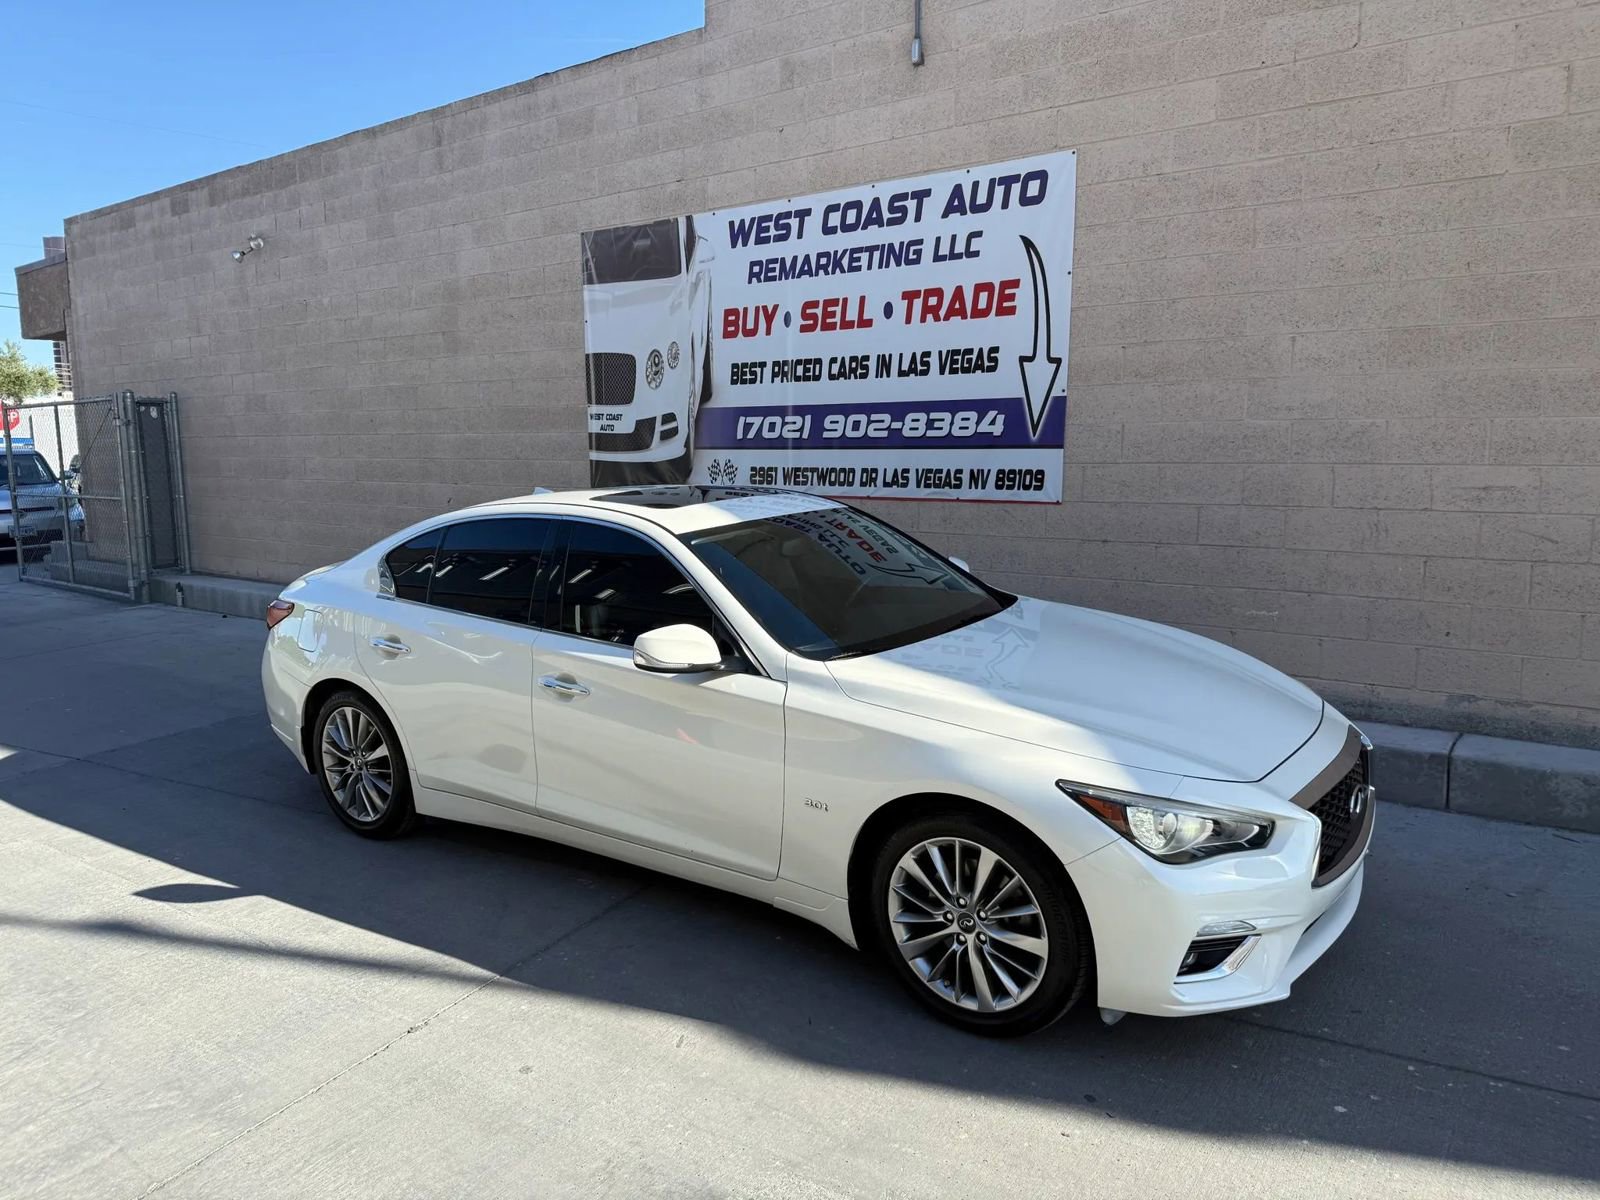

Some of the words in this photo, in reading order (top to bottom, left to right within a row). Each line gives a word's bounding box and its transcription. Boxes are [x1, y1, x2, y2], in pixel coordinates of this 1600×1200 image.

[728, 207, 812, 249] WEST
[821, 188, 932, 236] COAST
[941, 169, 1049, 219] AUTO
[748, 238, 924, 285] REMARKETING
[932, 230, 983, 263] LLC
[722, 303, 779, 339] BUY
[799, 295, 873, 333] SELL
[900, 278, 1021, 325] TRADE
[730, 362, 767, 386] BEST
[770, 357, 822, 384] PRICED
[828, 354, 870, 381] CARS
[875, 352, 892, 379] IN
[897, 350, 930, 377] LAS
[938, 345, 1000, 375] VEGAS
[600, 424, 615, 432] AUTO
[605, 413, 623, 421] COAST
[736, 414, 812, 440] (702)
[822, 410, 1005, 439] 902-8384
[749, 466, 778, 486] 2961
[781, 466, 856, 488] WESTWOOD
[859, 467, 878, 489] DR
[882, 467, 910, 490] LAS
[915, 467, 964, 490] VEGAS
[968, 468, 991, 490] NV
[994, 468, 1045, 492] 89109
